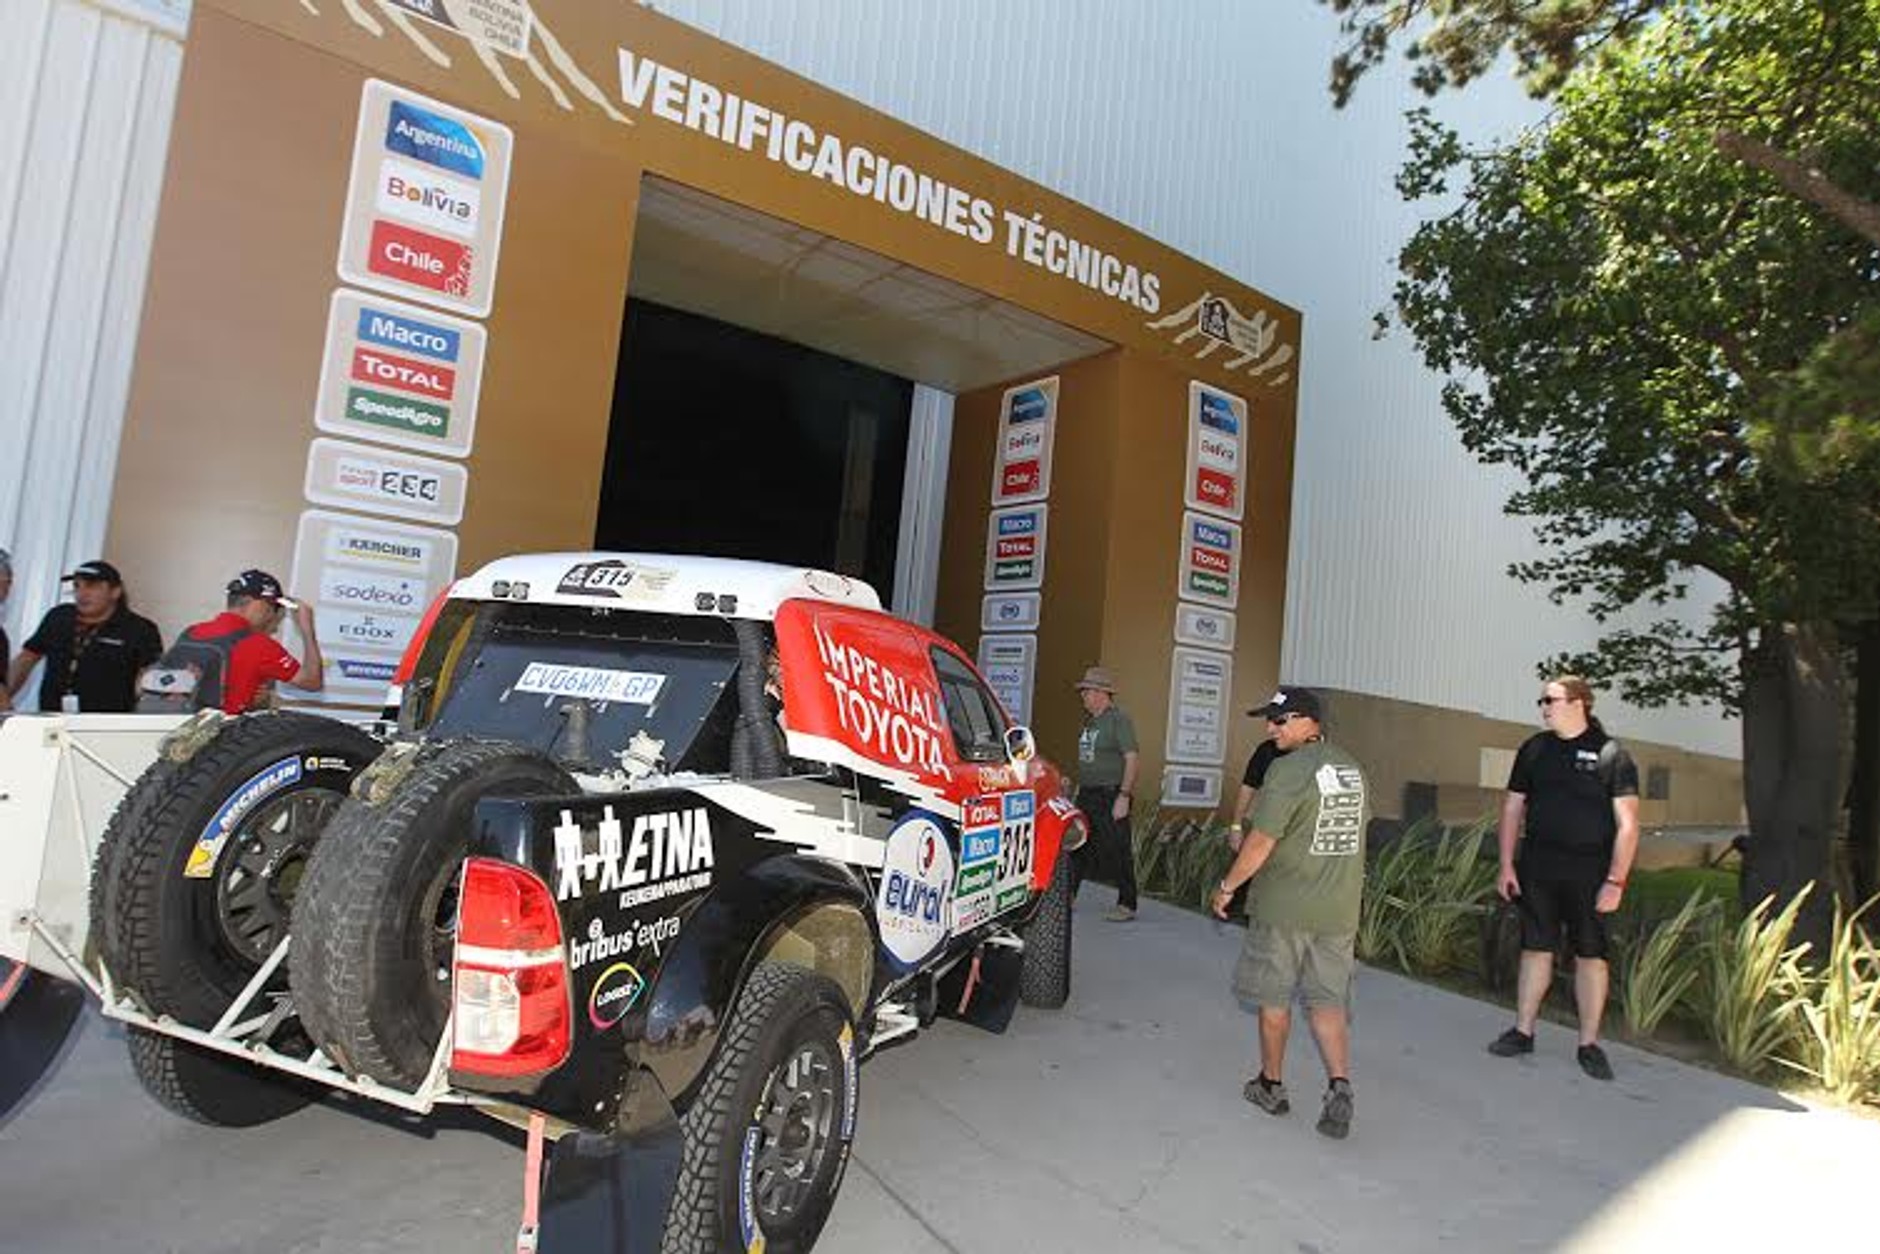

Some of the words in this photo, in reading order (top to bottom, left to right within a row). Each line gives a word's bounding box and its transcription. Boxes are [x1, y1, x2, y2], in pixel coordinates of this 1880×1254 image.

[393, 119, 478, 160] Argentina
[386, 176, 471, 219] Bolivia
[618, 47, 994, 244] VERIFICACIONES
[1003, 210, 1160, 314] TÉCNICAS
[384, 241, 444, 274] Chile
[370, 316, 448, 352] Macro
[360, 354, 447, 391] TOTAL
[333, 583, 413, 606] sodexo
[591, 569, 635, 587] 315
[813, 620, 939, 731] IMPERIAL
[824, 671, 952, 783] TOYOTA
[219, 764, 297, 833] MICHELIN
[621, 807, 714, 885] ETNA
[997, 822, 1031, 882] 315
[637, 916, 681, 957] extra
